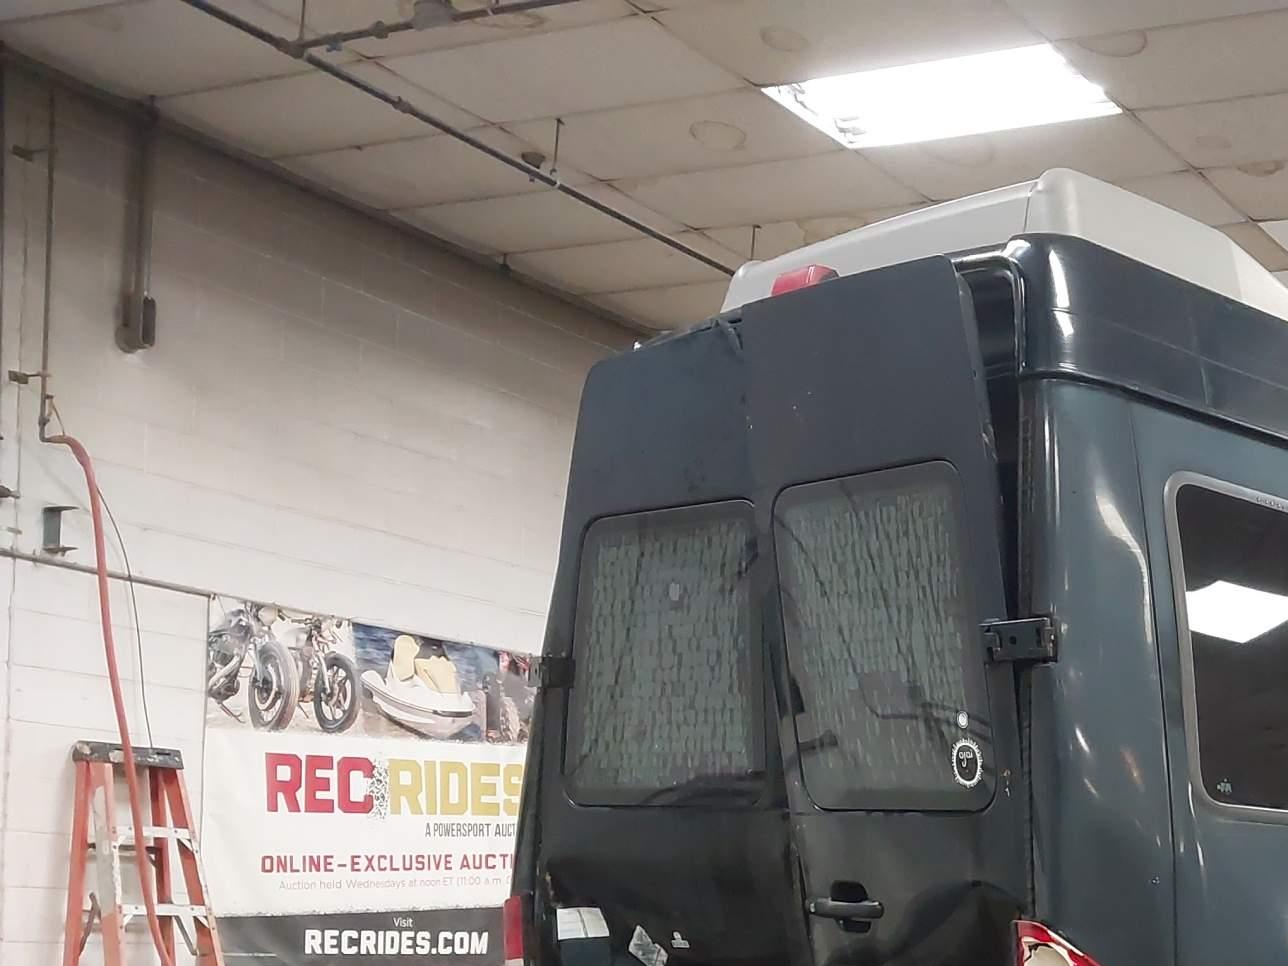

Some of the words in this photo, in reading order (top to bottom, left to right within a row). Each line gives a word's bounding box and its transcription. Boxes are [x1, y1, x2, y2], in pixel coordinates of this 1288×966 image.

[265, 752, 376, 814] REC
[387, 758, 523, 816] RIDES
[424, 822, 432, 838] A
[433, 822, 492, 838] POWERSPORT
[260, 854, 453, 873] ONLINE-EXCLUSIVE
[279, 879, 316, 890] Auction
[319, 879, 342, 889] held
[345, 878, 406, 890] Wednesdays
[408, 878, 417, 888] at
[419, 878, 441, 888] noon
[442, 876, 453, 886] ET
[393, 917, 413, 928] Visit
[304, 929, 489, 955] RECRIDES.COM
